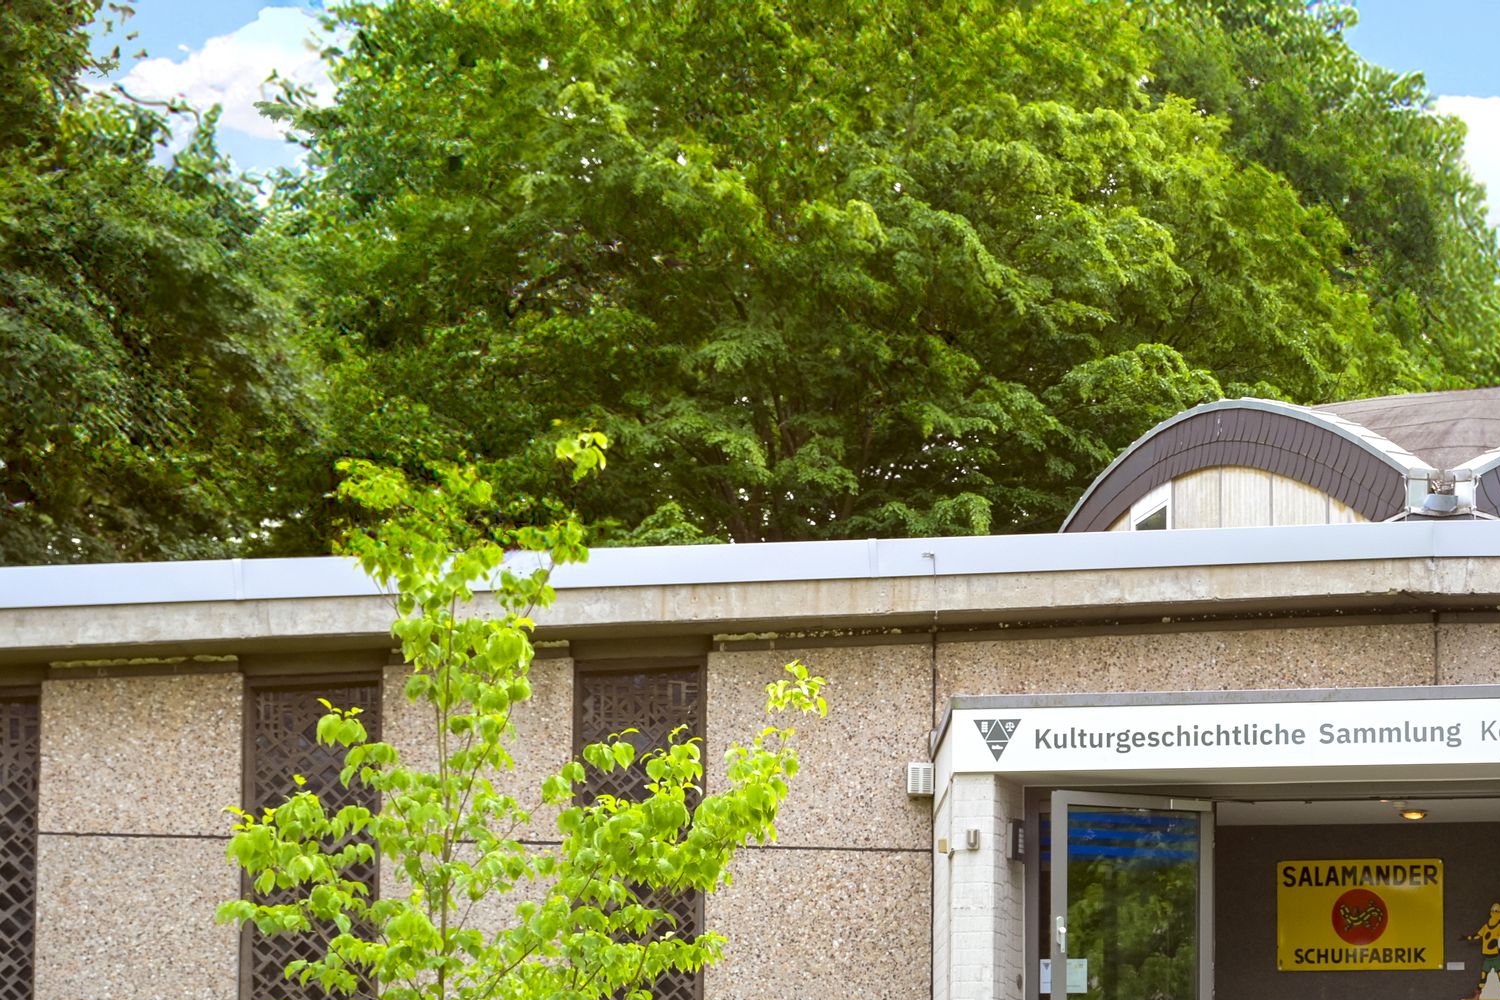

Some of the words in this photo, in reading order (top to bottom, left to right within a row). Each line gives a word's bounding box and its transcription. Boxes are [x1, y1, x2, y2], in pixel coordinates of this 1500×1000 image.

[1034, 721, 1306, 754] Kulturgeschichtliche
[1319, 719, 1463, 748] Sammlung
[1282, 864, 1439, 888] SALAMANDER
[1294, 947, 1426, 965] SCHUHFABRIK
